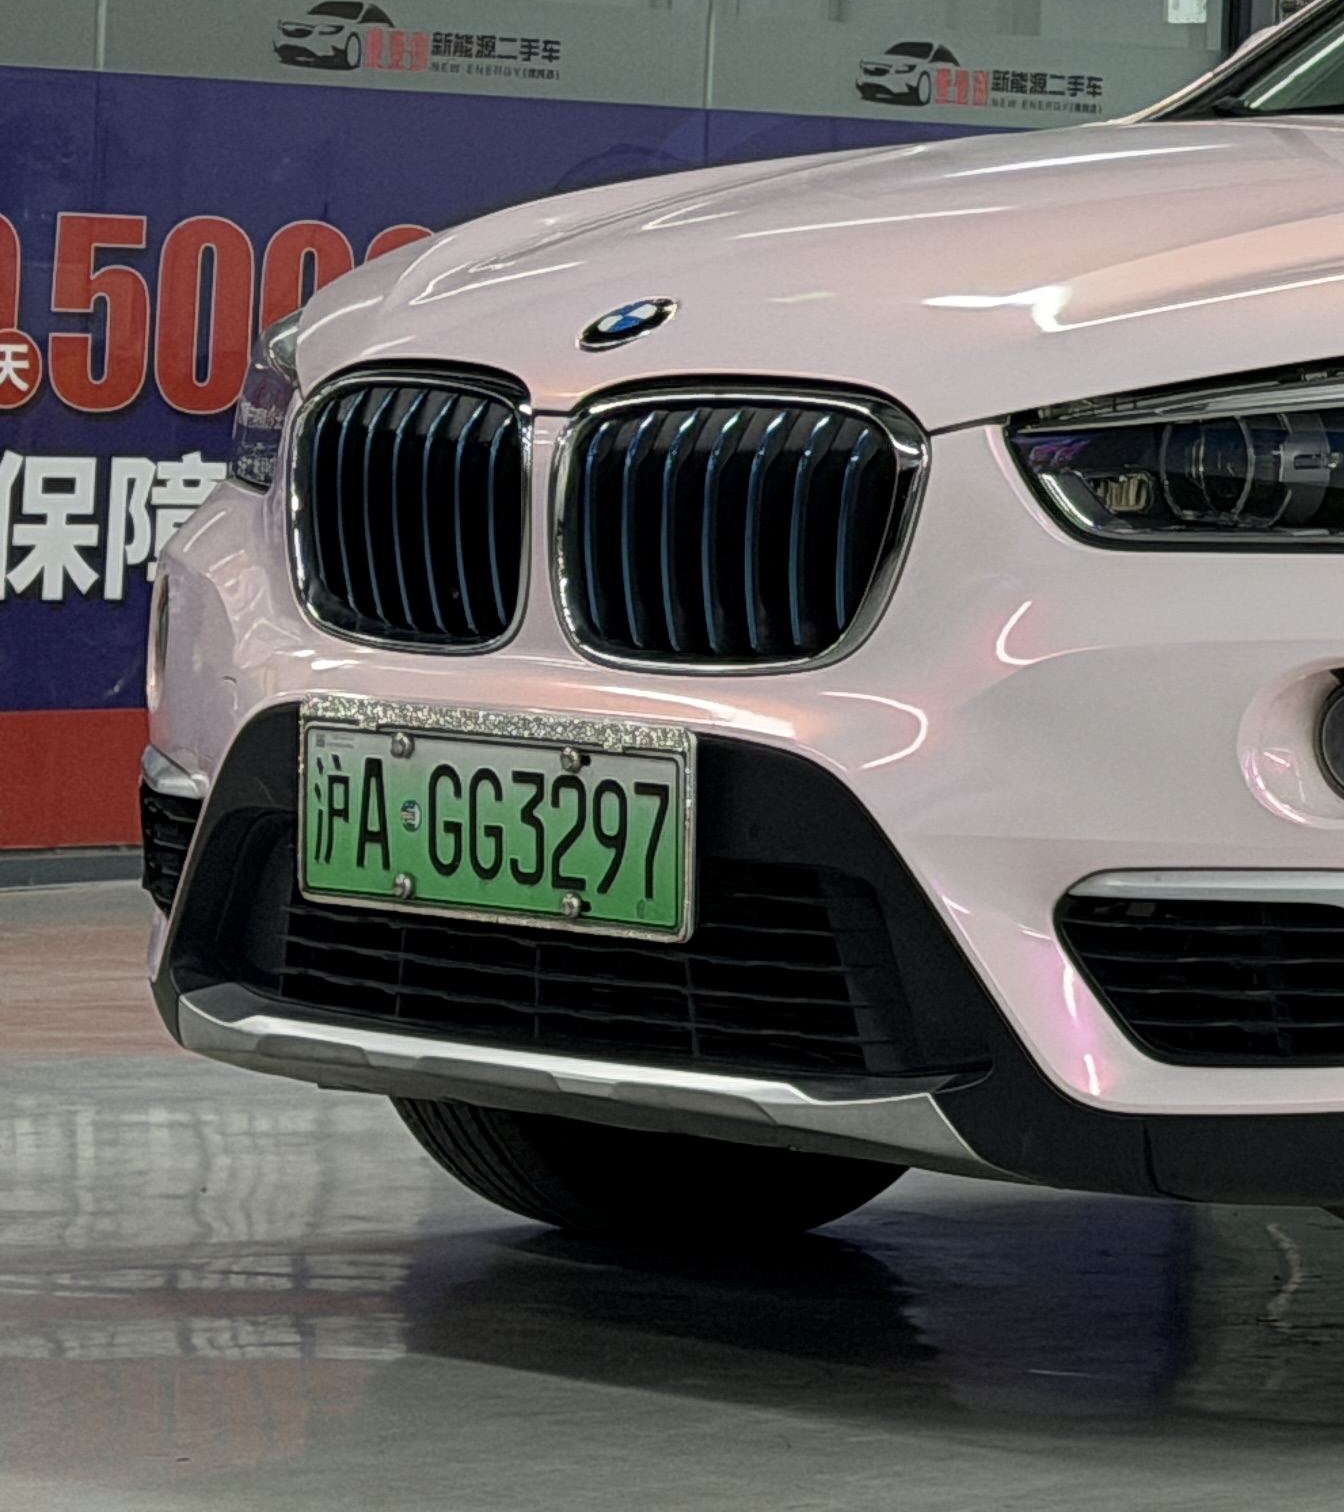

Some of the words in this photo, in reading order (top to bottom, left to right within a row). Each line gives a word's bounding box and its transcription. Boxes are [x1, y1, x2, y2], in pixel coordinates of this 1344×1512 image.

[430, 30, 561, 63] 新能源二手车
[991, 69, 1103, 98] 新能源二手车
[48, 212, 432, 414] 500
